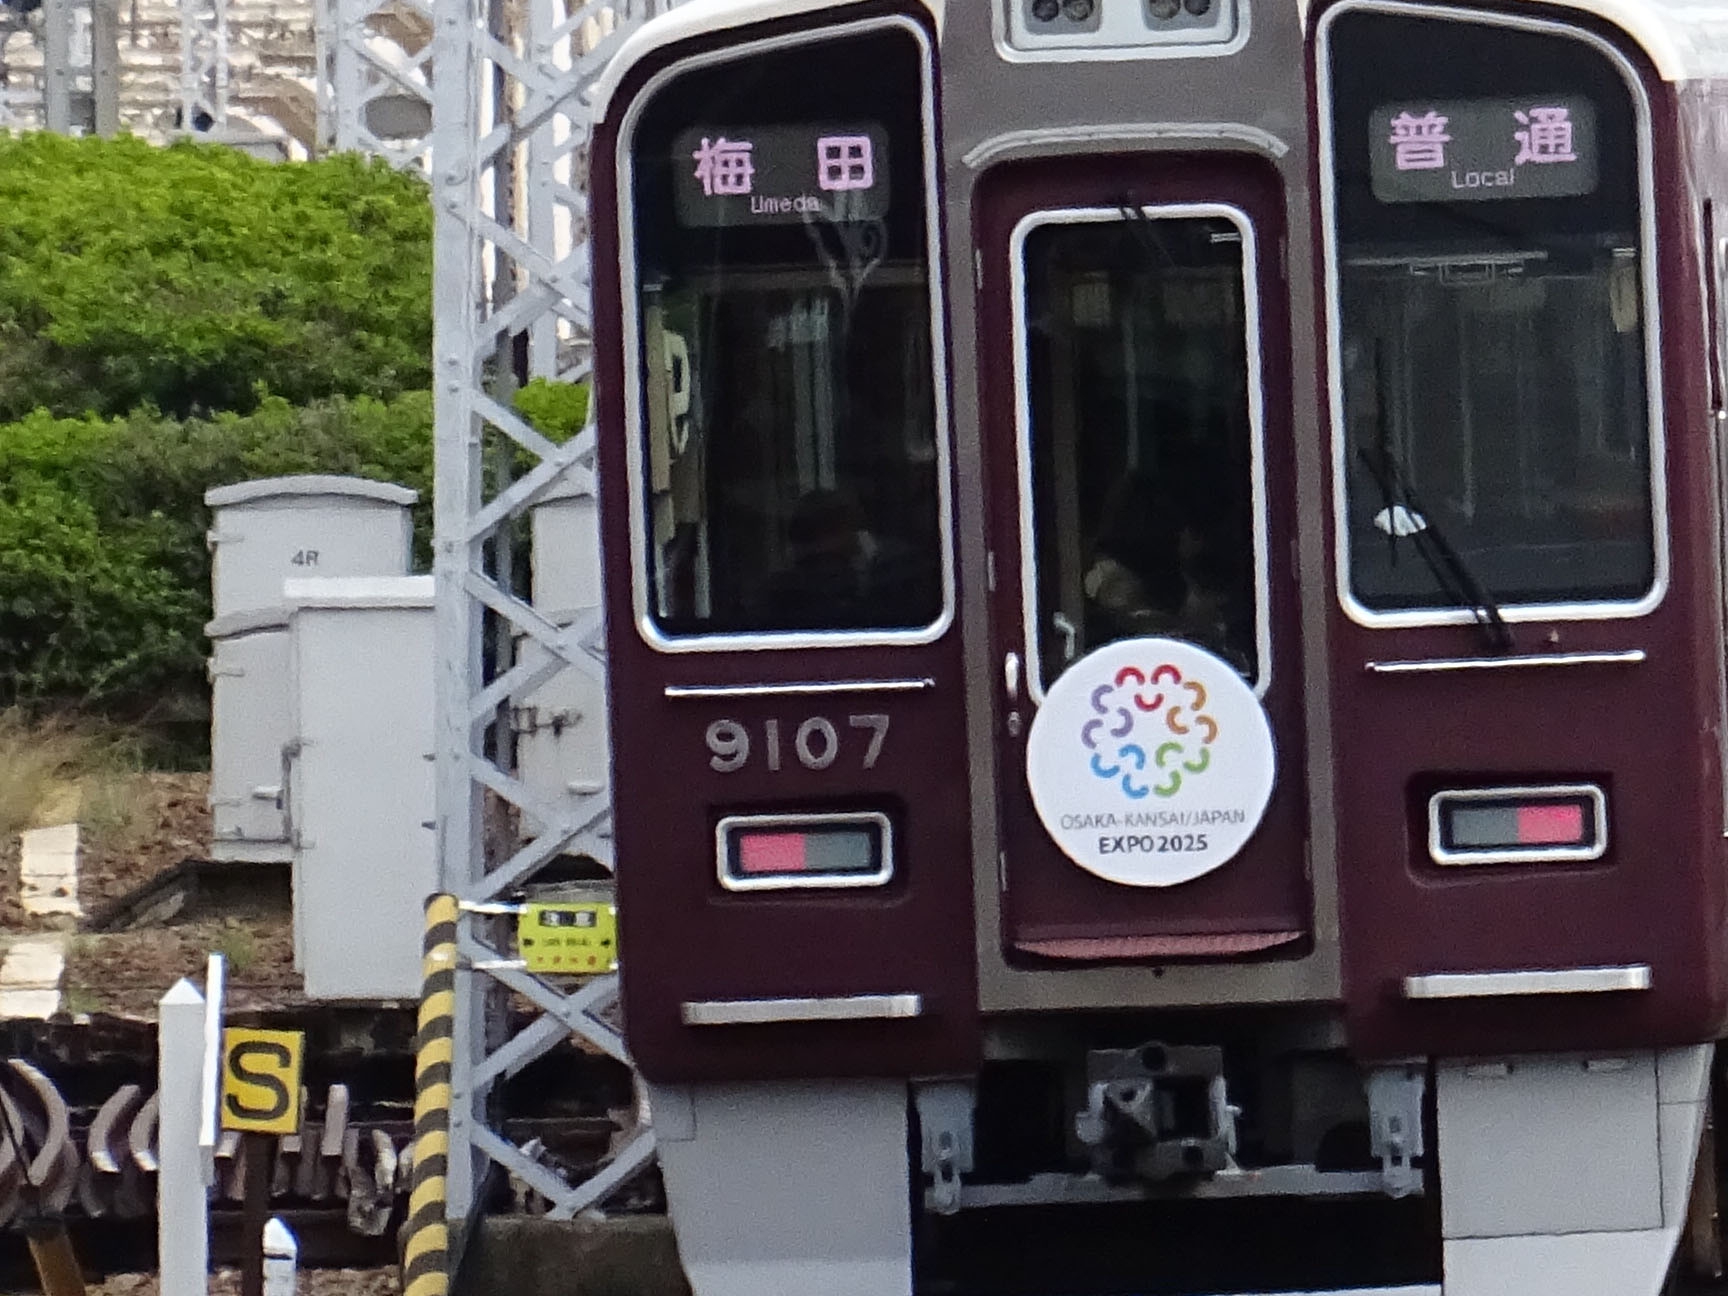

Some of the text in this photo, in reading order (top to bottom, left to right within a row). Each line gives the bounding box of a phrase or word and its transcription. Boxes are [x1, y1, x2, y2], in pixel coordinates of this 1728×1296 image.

[692, 136, 873, 196] 梅田
[1389, 106, 1578, 171] 普通
[750, 194, 821, 214] Umeda
[1451, 168, 1515, 189] Local
[705, 714, 890, 773] 9107
[227, 1040, 292, 1121] S
